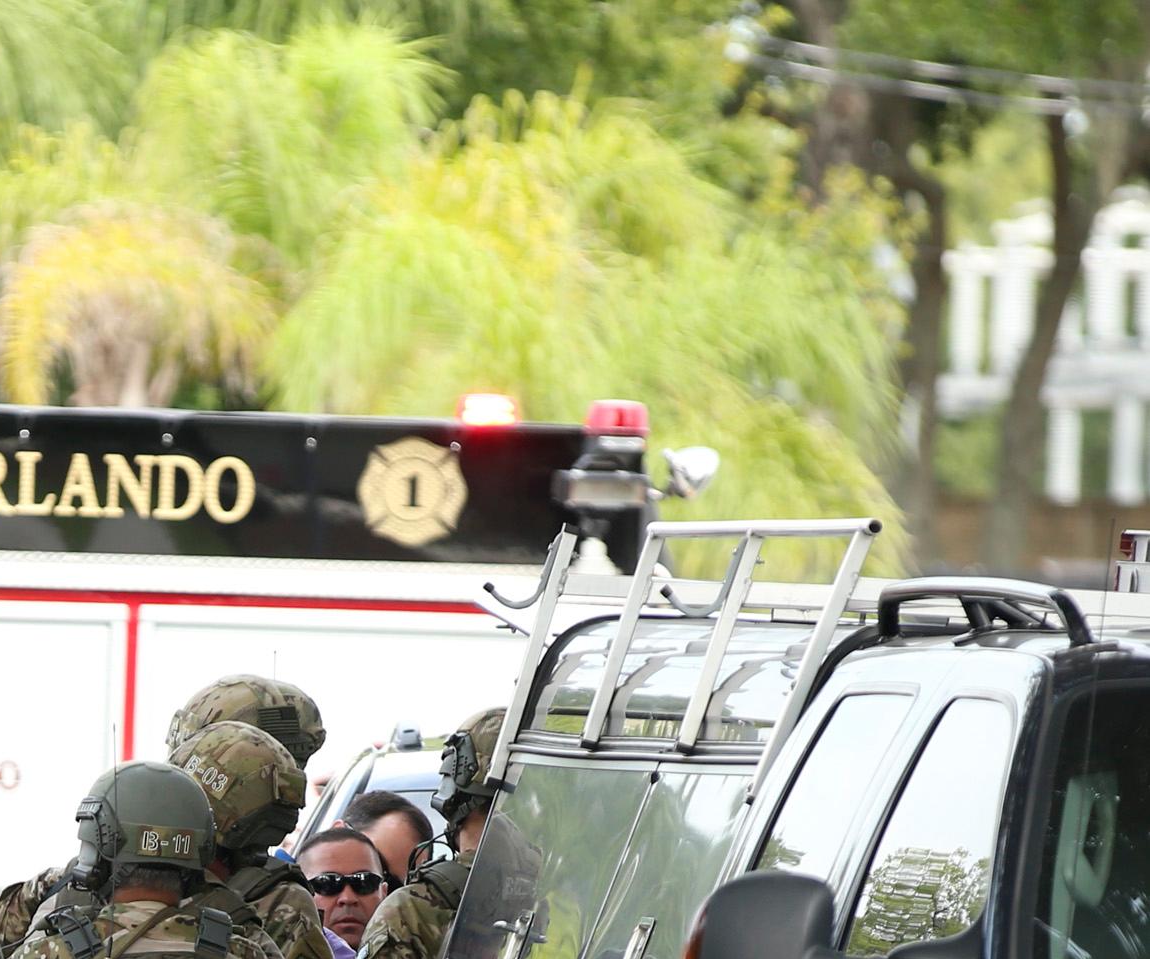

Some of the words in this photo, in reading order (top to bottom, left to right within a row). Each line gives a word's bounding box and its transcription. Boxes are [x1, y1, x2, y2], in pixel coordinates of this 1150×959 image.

[401, 473, 423, 508] 1
[183, 754, 229, 792] B-03
[141, 830, 191, 855] B-11
